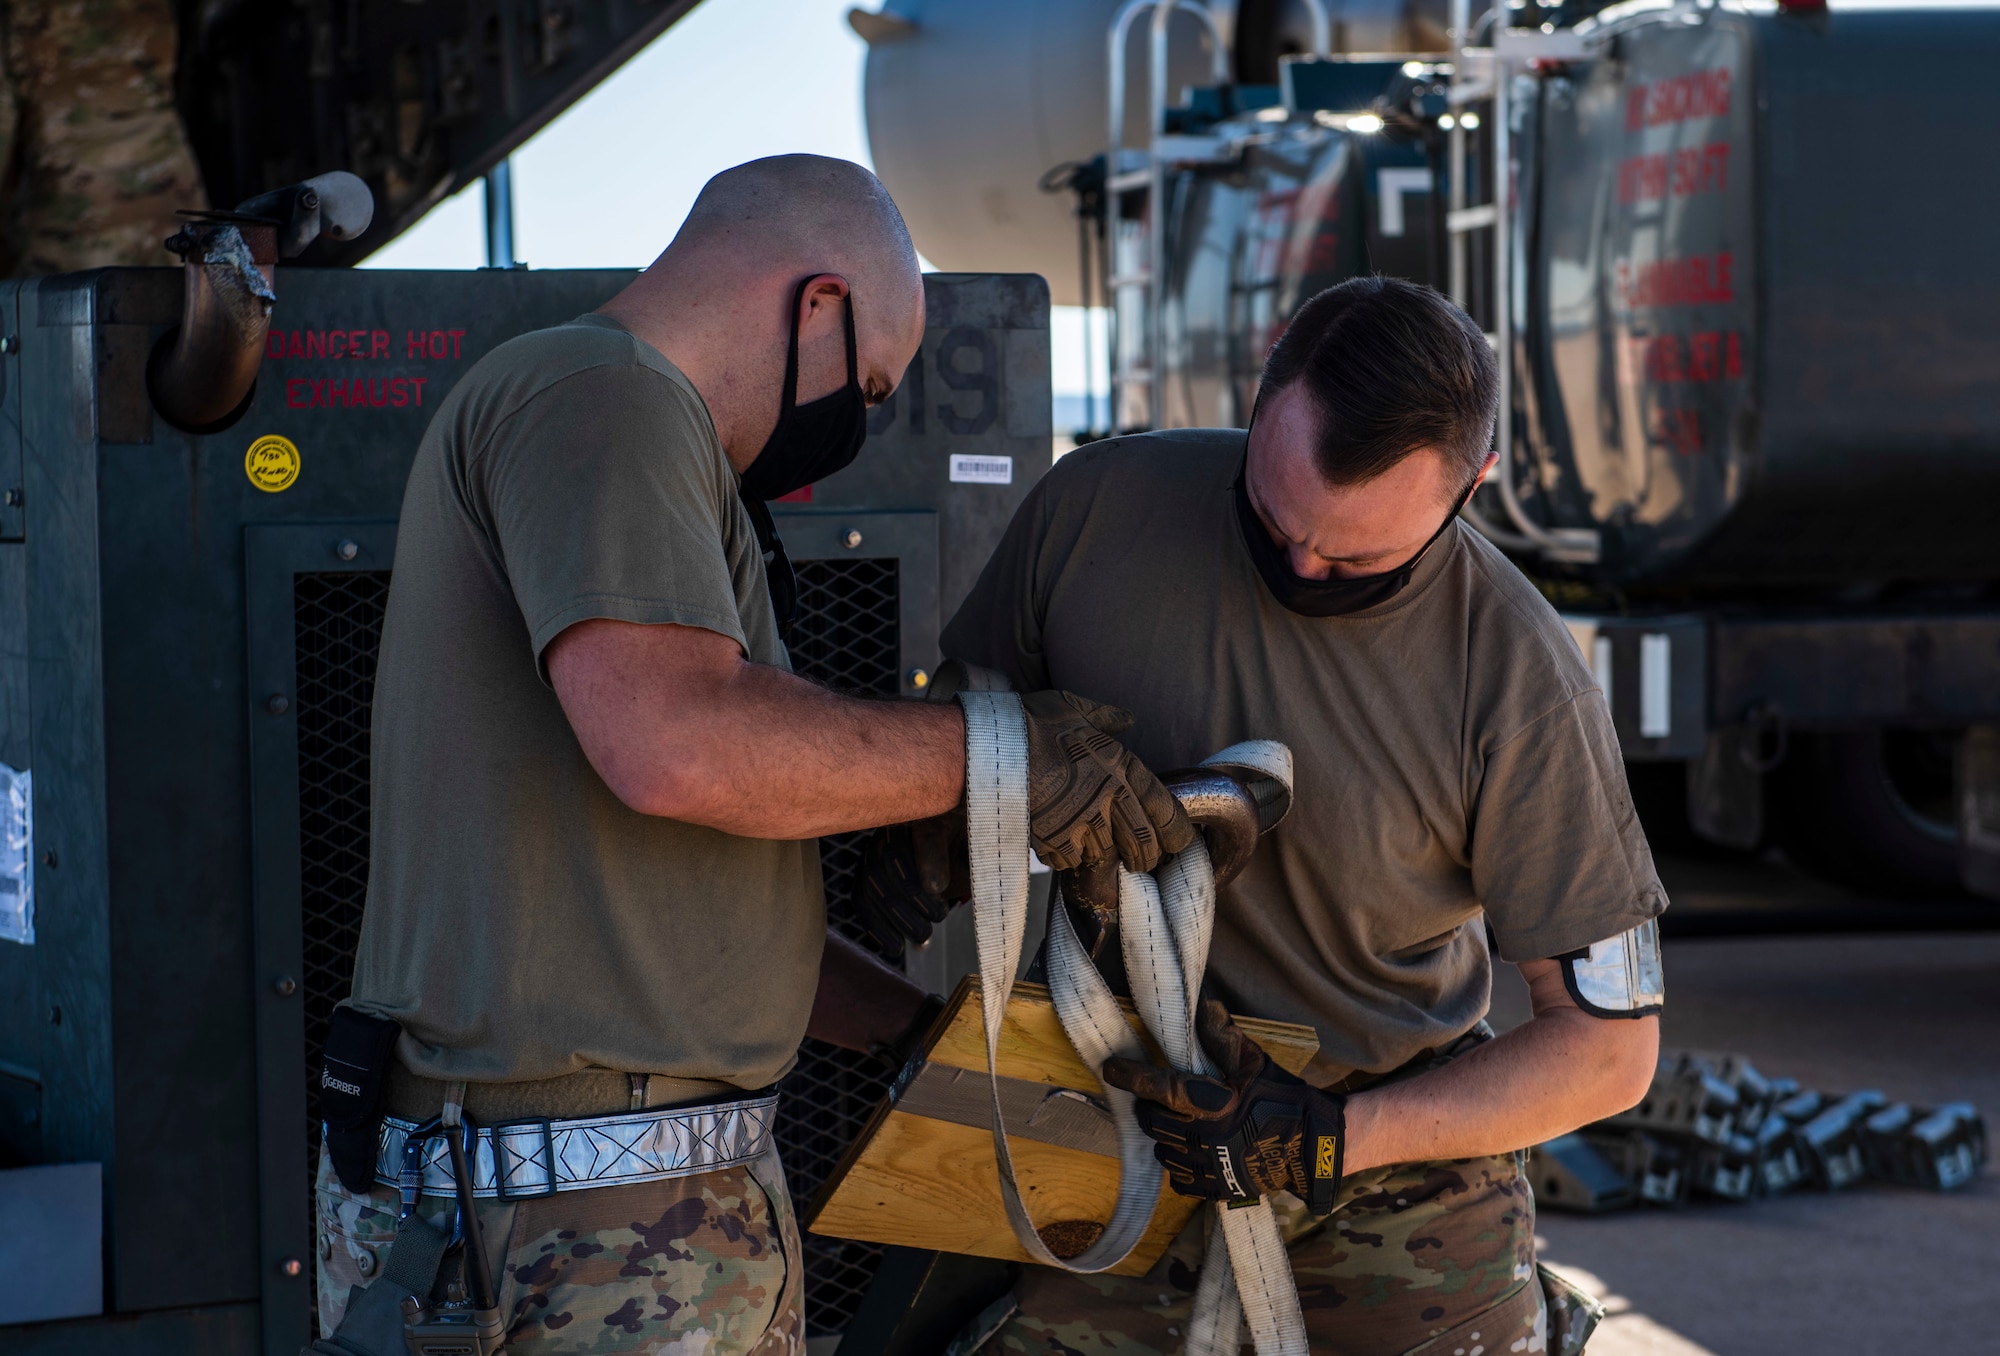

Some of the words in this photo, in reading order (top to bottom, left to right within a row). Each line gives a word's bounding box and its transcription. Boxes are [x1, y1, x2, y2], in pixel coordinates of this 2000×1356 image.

[267, 330, 390, 359] DANGER
[407, 330, 466, 359] HOT
[287, 378, 427, 409] EXHAUST
[327, 1076, 361, 1097] GERBER
